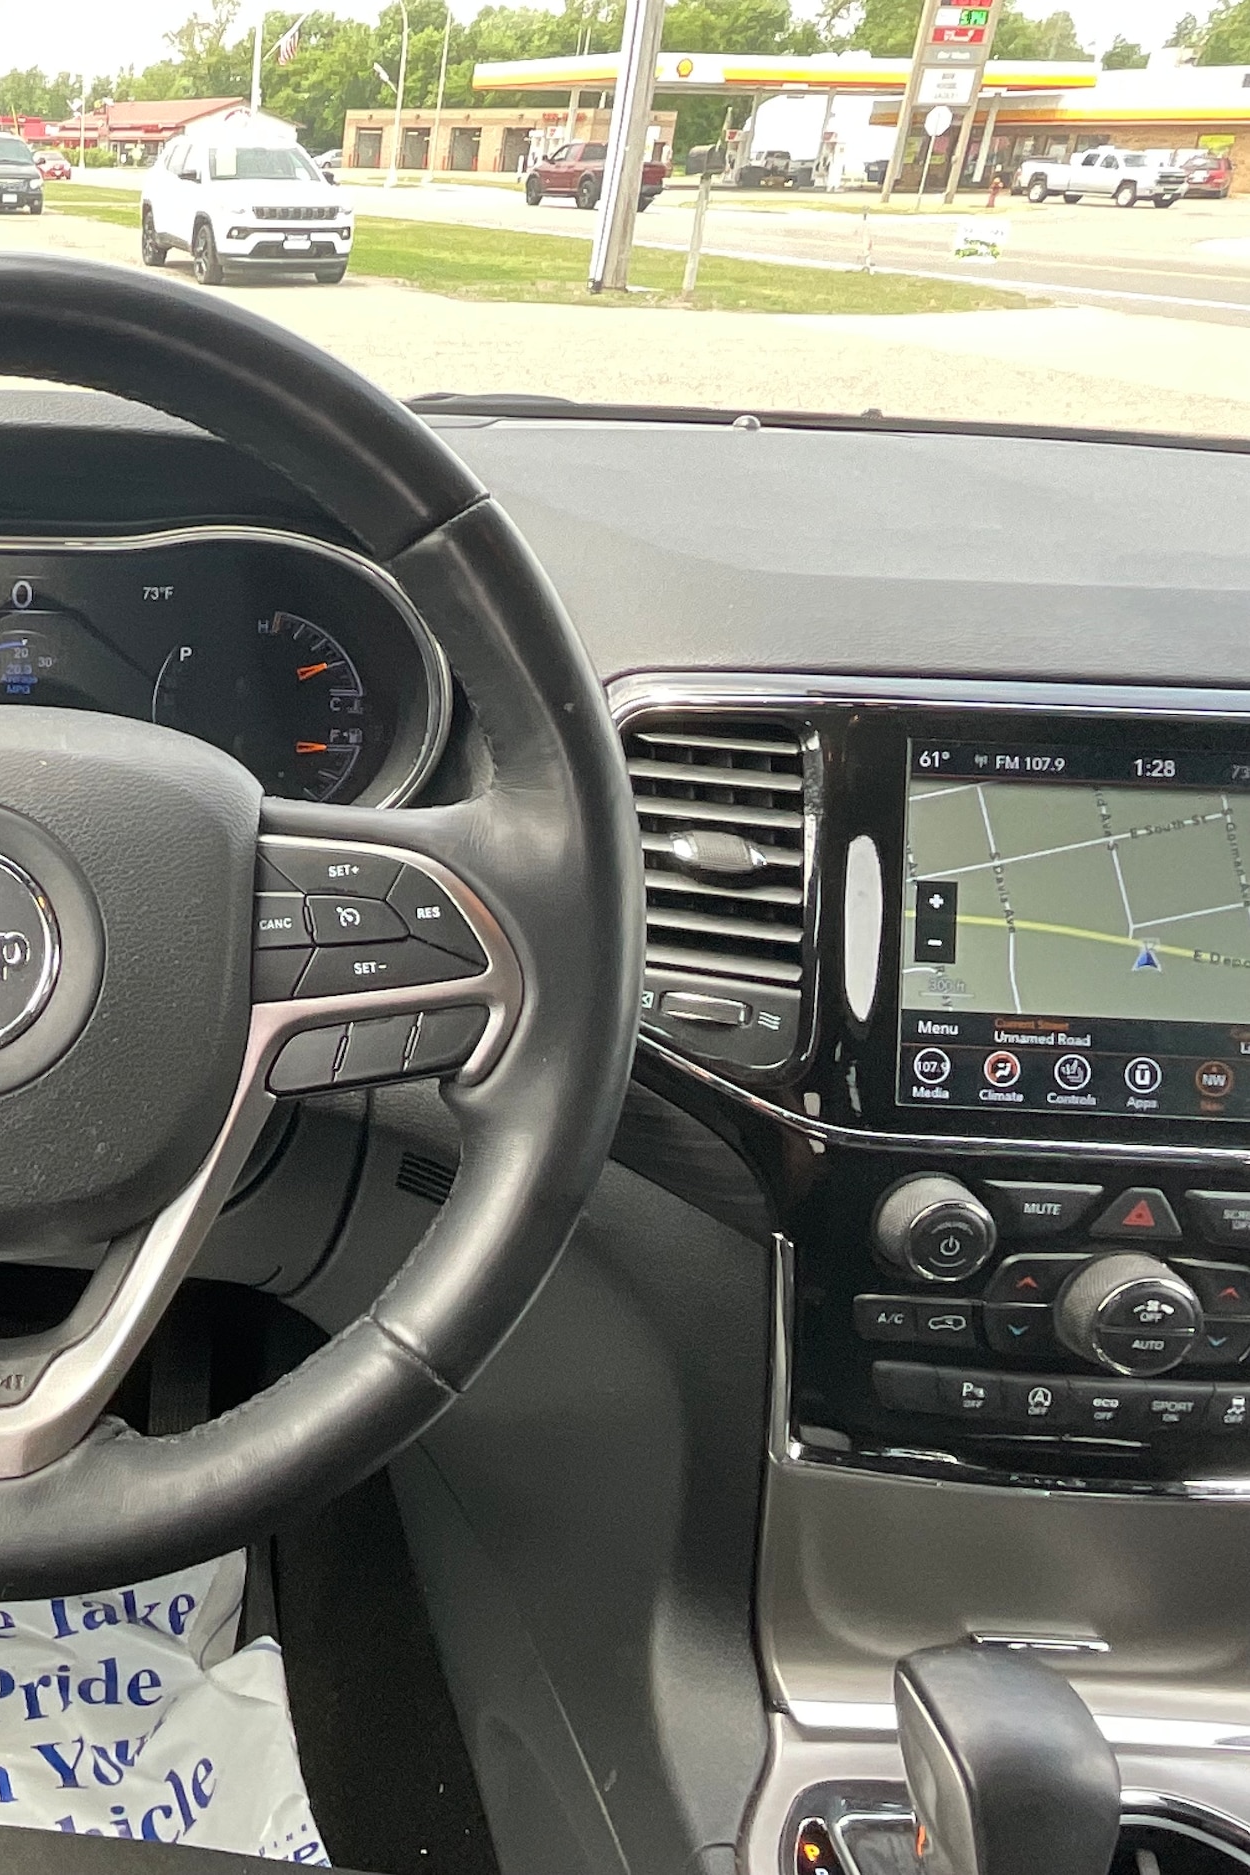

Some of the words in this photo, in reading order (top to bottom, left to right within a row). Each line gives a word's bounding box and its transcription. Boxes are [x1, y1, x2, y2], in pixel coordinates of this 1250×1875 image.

[12, 580, 33, 609] 0
[143, 586, 174, 600] 73°F
[258, 619, 269, 633] H
[13, 648, 29, 659] 20
[179, 647, 192, 661] P
[38, 656, 53, 667] 30
[330, 697, 341, 711] C
[330, 728, 341, 743] F
[919, 751, 950, 768] 61°
[995, 755, 1019, 770] FM
[1024, 757, 1065, 772] 107.9
[1133, 758, 1176, 777] 1:28
[416, 906, 441, 919] RES
[259, 918, 292, 930] CANC
[917, 1020, 959, 1035] Menu
[994, 1031, 1054, 1045] Unnamed
[1058, 1033, 1092, 1047] Road
[1201, 1073, 1228, 1087] NW
[912, 1086, 950, 1099] Media
[979, 1089, 1024, 1103] Climate
[1046, 1092, 1097, 1106] Controls
[1126, 1096, 1159, 1111] Apps
[1023, 1203, 1062, 1216] MUTE
[877, 1312, 904, 1325] A/C
[1140, 1311, 1163, 1322] OFF
[1131, 1339, 1165, 1351] AUTO
[1092, 1398, 1119, 1408] eco
[1151, 1400, 1194, 1413] SPORT
[1027, 1406, 1049, 1416] OFF
[1093, 1411, 1114, 1421] OFF
[31, 1718, 166, 1789] You
[803, 1843, 820, 1862] P
